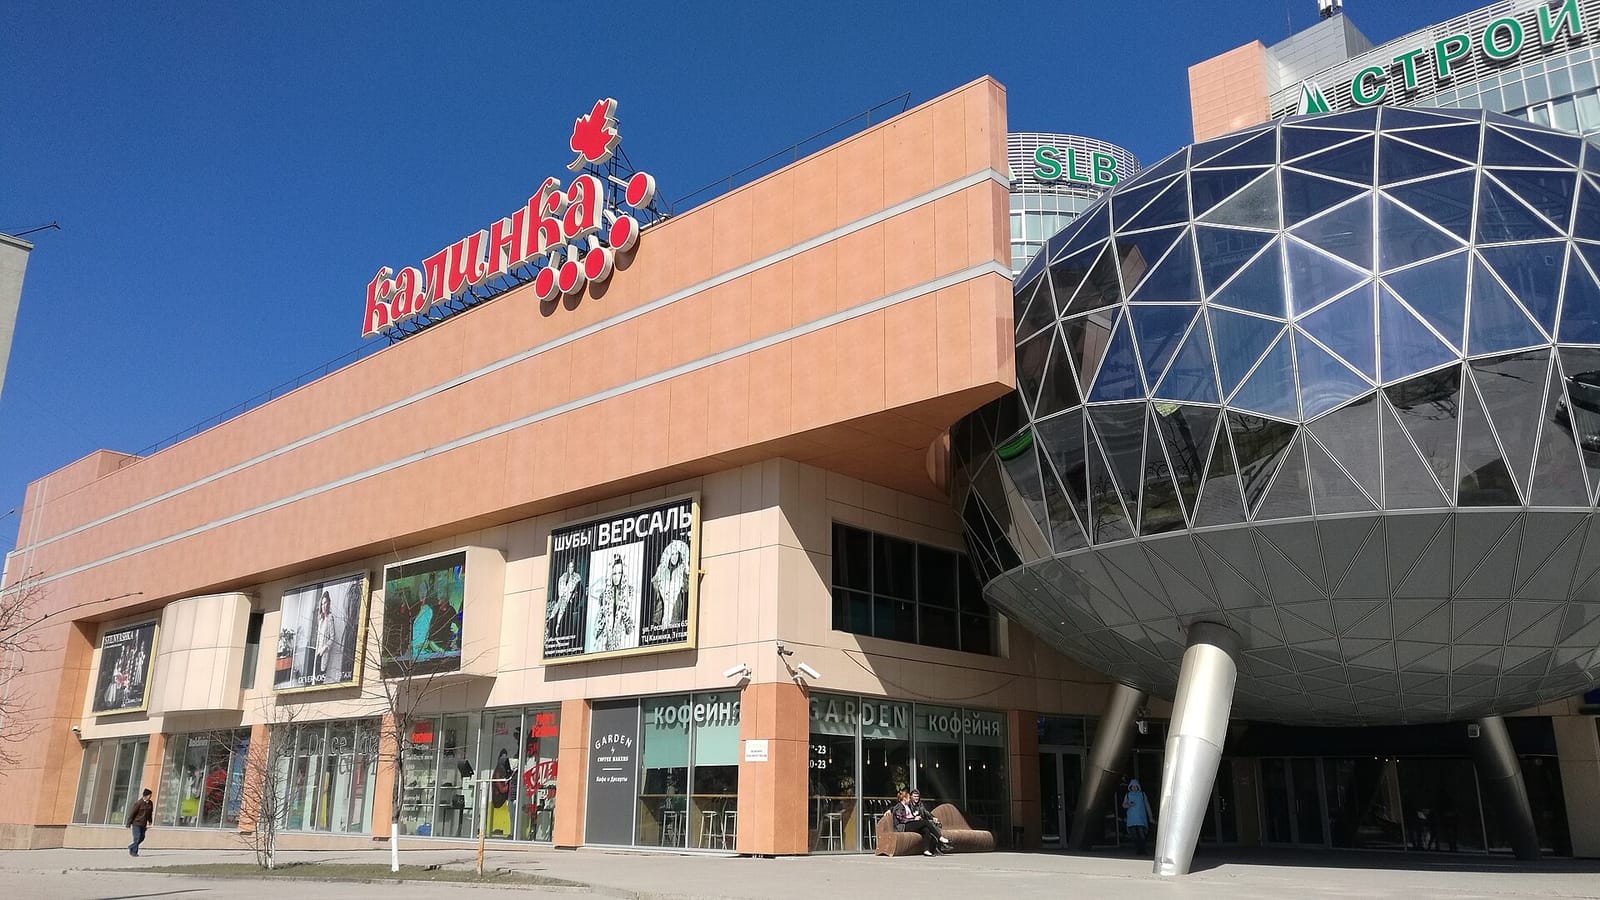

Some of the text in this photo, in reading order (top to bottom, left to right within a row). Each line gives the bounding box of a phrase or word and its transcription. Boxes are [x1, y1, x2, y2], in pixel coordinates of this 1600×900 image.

[1033, 145, 1120, 188] SLB
[554, 505, 692, 552] ШУБЫ ВЕРСАЛЬ
[594, 733, 632, 750] GARDEN
[928, 712, 1000, 738] кофейня
